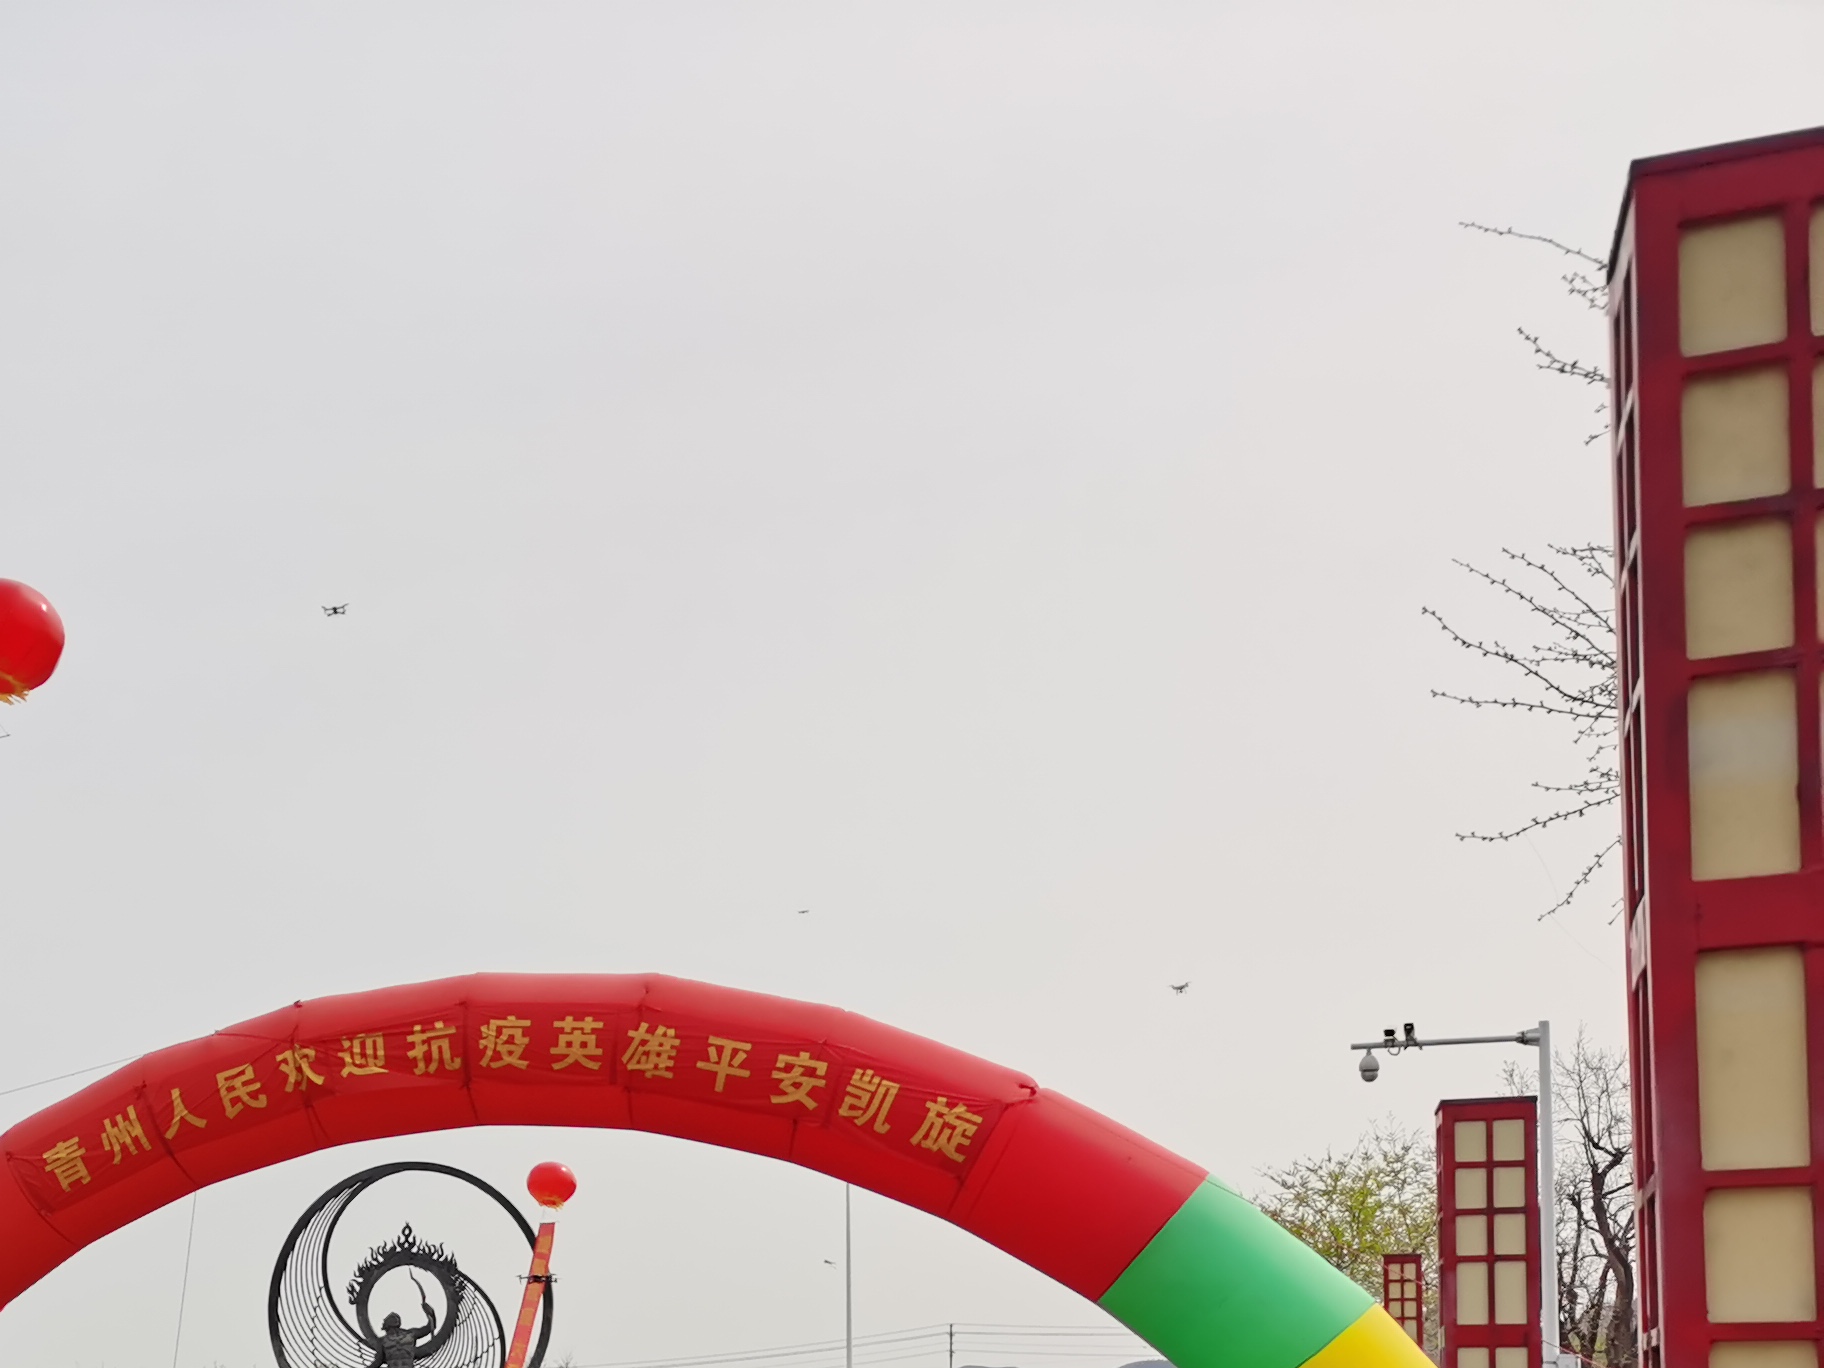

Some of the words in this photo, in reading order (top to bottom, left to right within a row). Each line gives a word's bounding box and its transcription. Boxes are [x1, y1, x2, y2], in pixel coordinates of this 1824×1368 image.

[41, 1014, 984, 1193] 青州人民欢迎抗疫英雄平安凯旋
